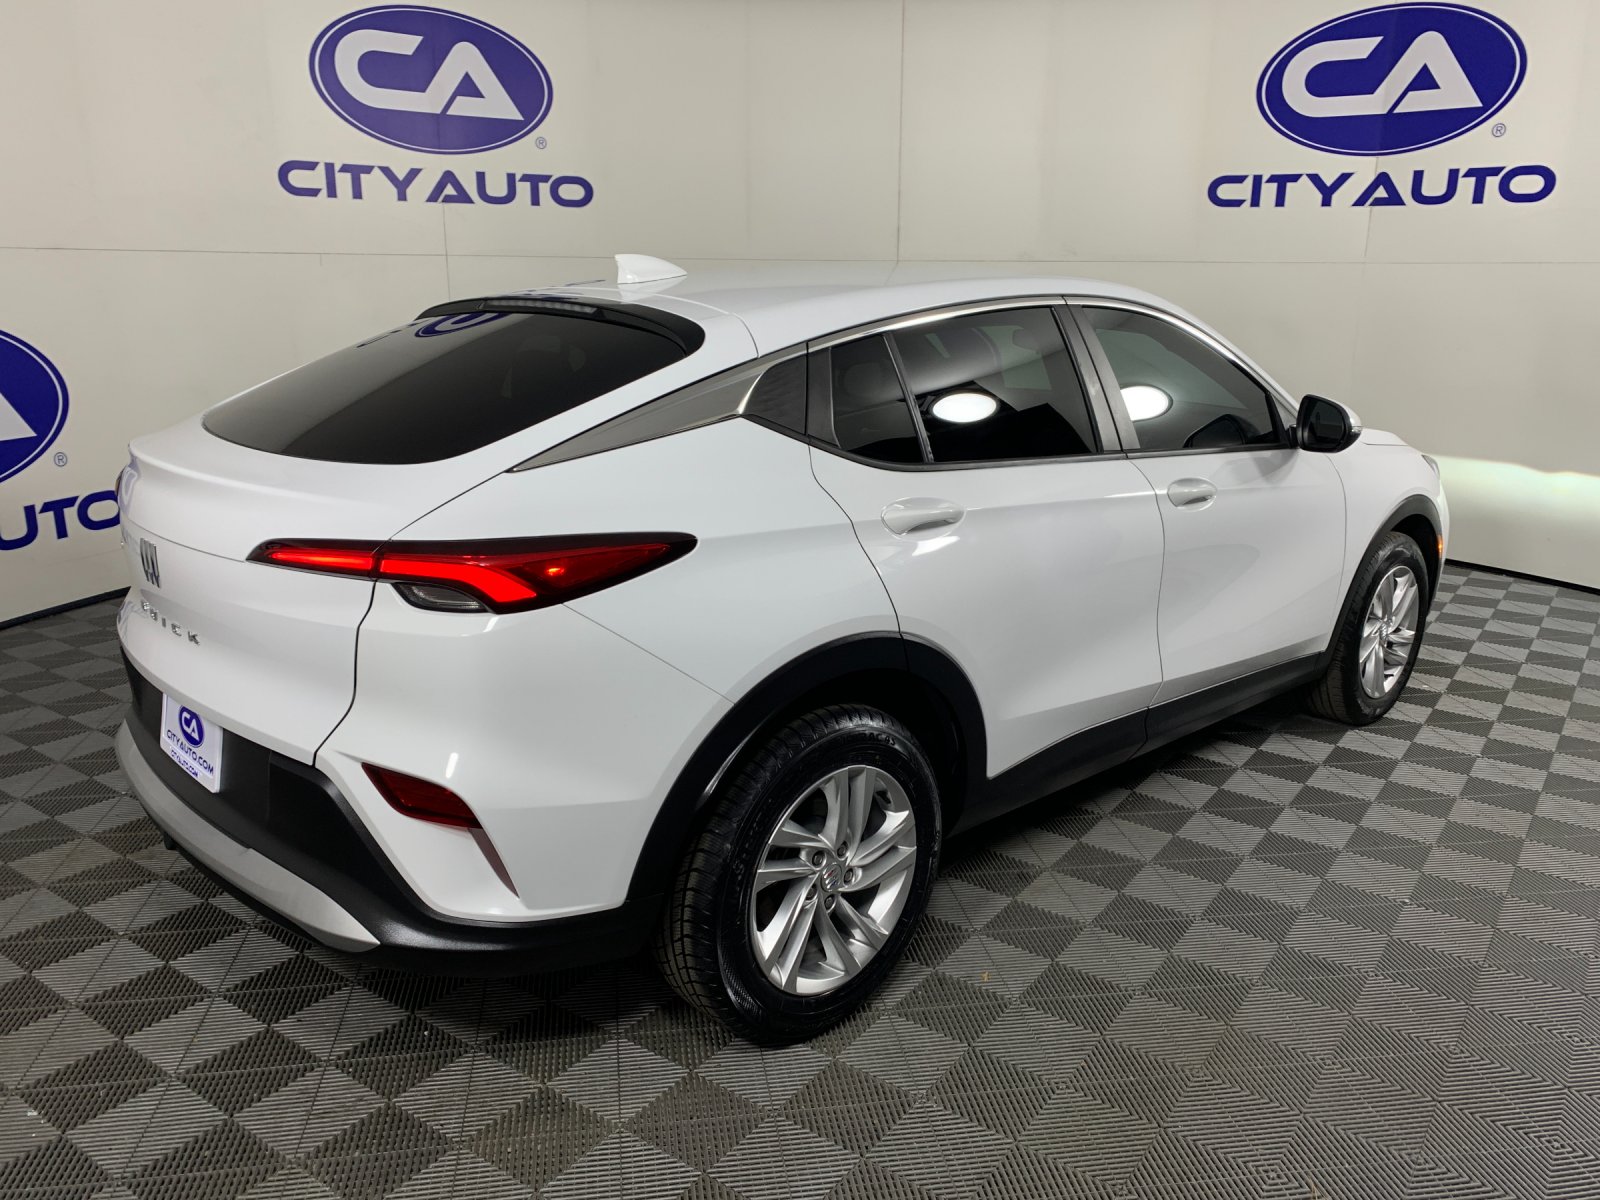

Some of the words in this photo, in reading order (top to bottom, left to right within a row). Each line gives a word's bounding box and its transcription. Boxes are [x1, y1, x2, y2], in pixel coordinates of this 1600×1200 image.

[334, 29, 525, 121] CA
[1281, 30, 1484, 118] CA
[181, 711, 200, 742] CA
